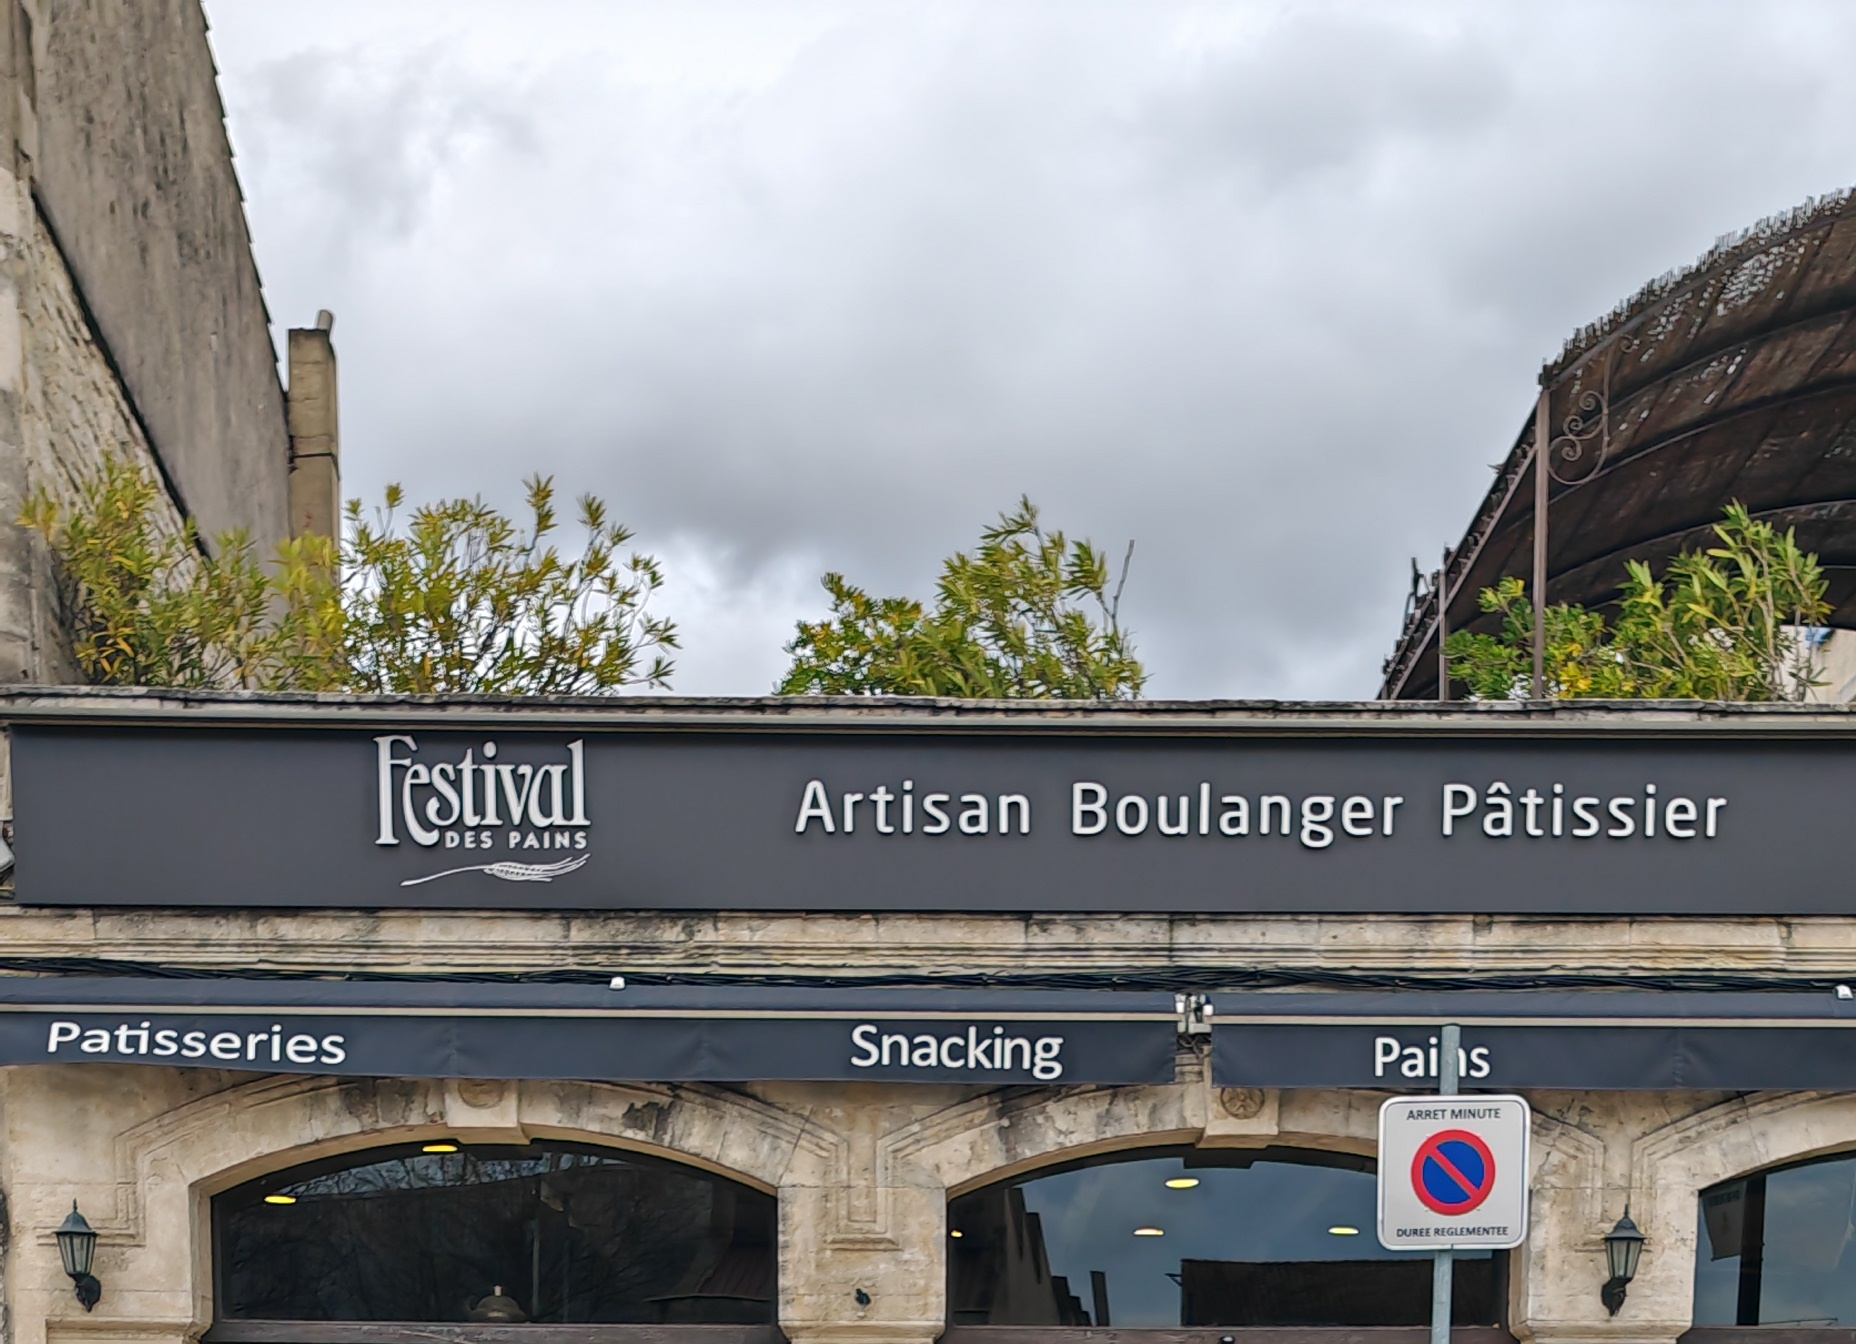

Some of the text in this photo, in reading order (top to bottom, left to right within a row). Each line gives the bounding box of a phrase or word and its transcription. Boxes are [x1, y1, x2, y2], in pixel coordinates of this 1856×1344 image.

[375, 737, 590, 848] Festival
[796, 781, 1726, 847] Artisan Boulanger Pâtissier
[446, 832, 586, 848] DES PAINS
[48, 1022, 345, 1063] Patisseries
[852, 1025, 1063, 1079] Snacking
[1406, 1107, 1501, 1121] ARRET MINUTE
[1395, 1226, 1509, 1238] DUREE REGLEMENTEE
